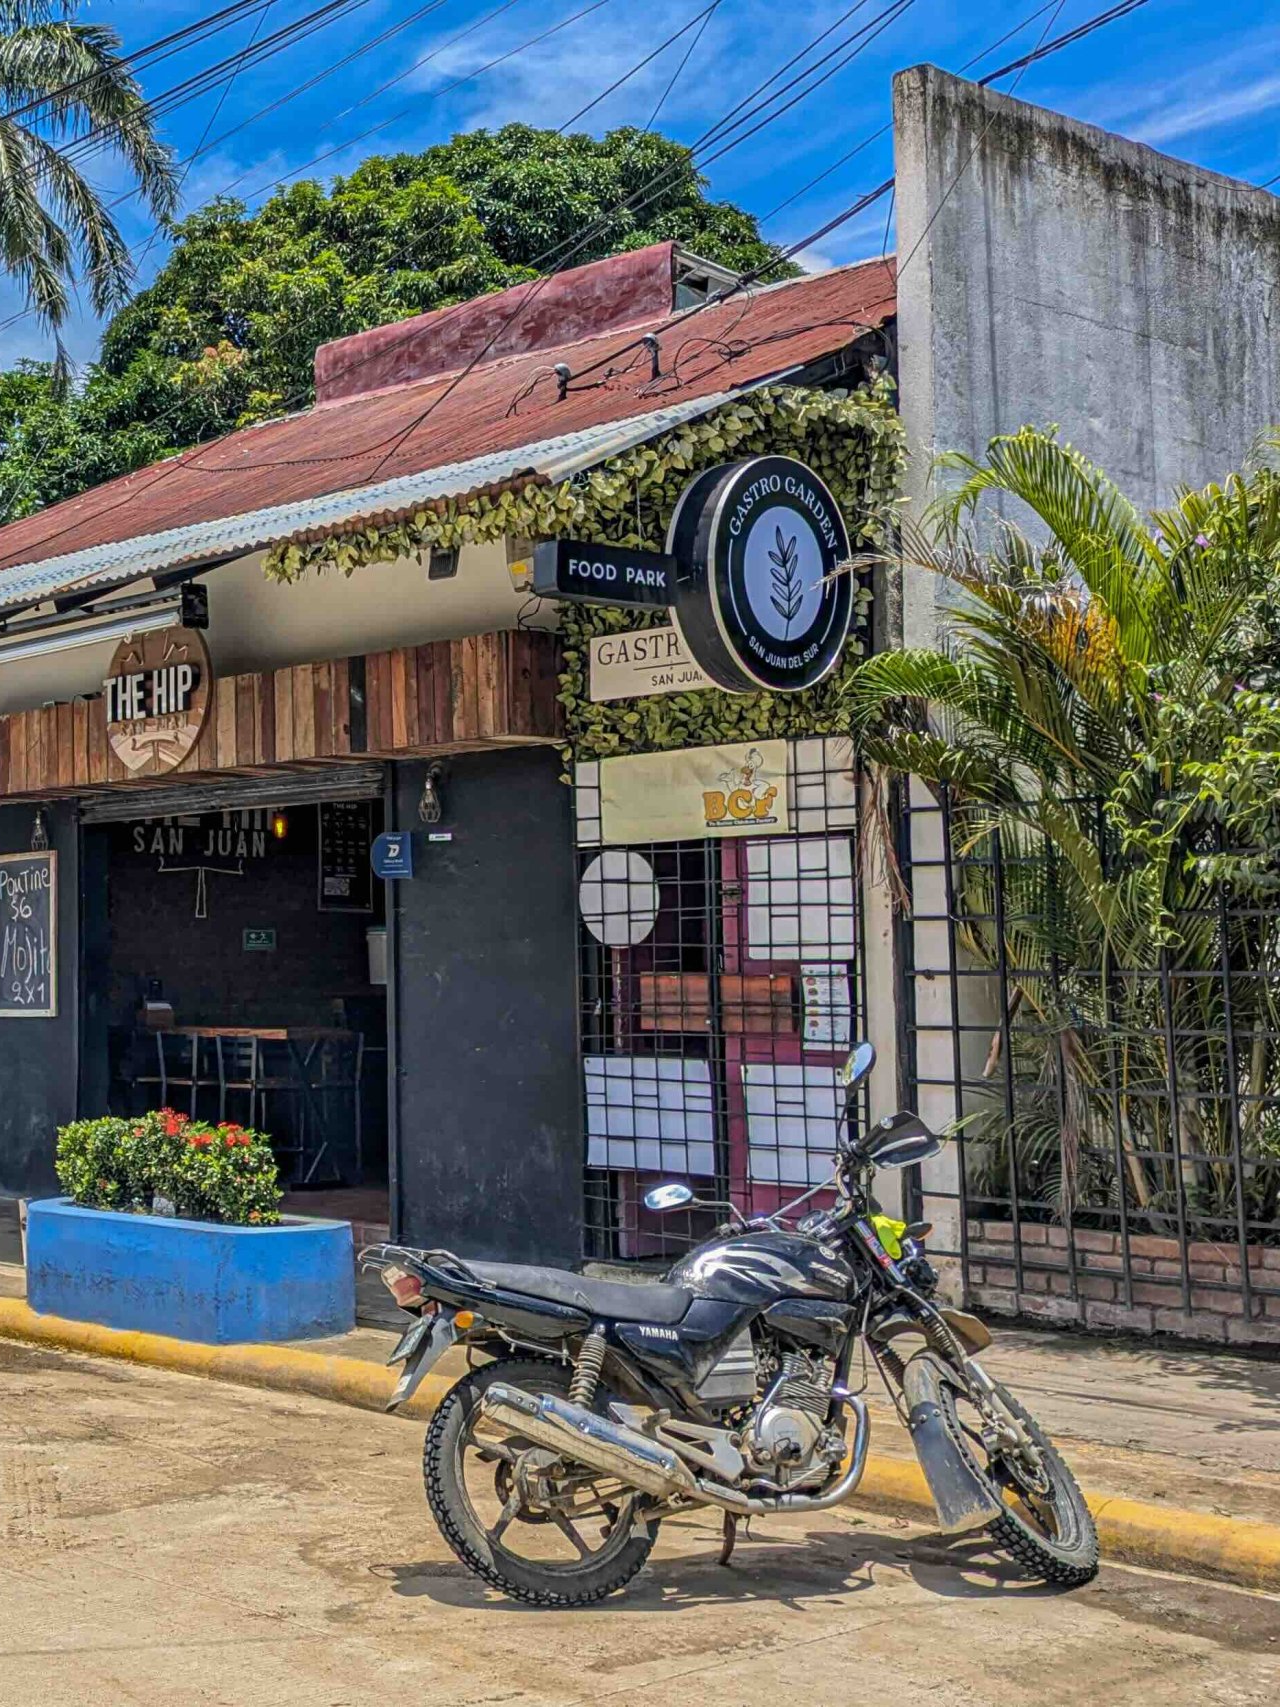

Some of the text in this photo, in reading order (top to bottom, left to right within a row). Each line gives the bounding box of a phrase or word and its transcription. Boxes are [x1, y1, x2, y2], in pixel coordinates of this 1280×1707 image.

[729, 474, 839, 549] GASTRO GARDEN
[568, 558, 667, 588] FOOD PARK
[597, 631, 681, 666] GASTR
[748, 635, 820, 669] SAN JUAN DEL SUR
[102, 664, 192, 723] THE HIP
[651, 670, 703, 688] SAN JUA
[703, 786, 778, 821] BCF
[133, 826, 266, 858] SAN JUAN
[10, 894, 33, 922] $6
[639, 1325, 679, 1341] YAMAHA
